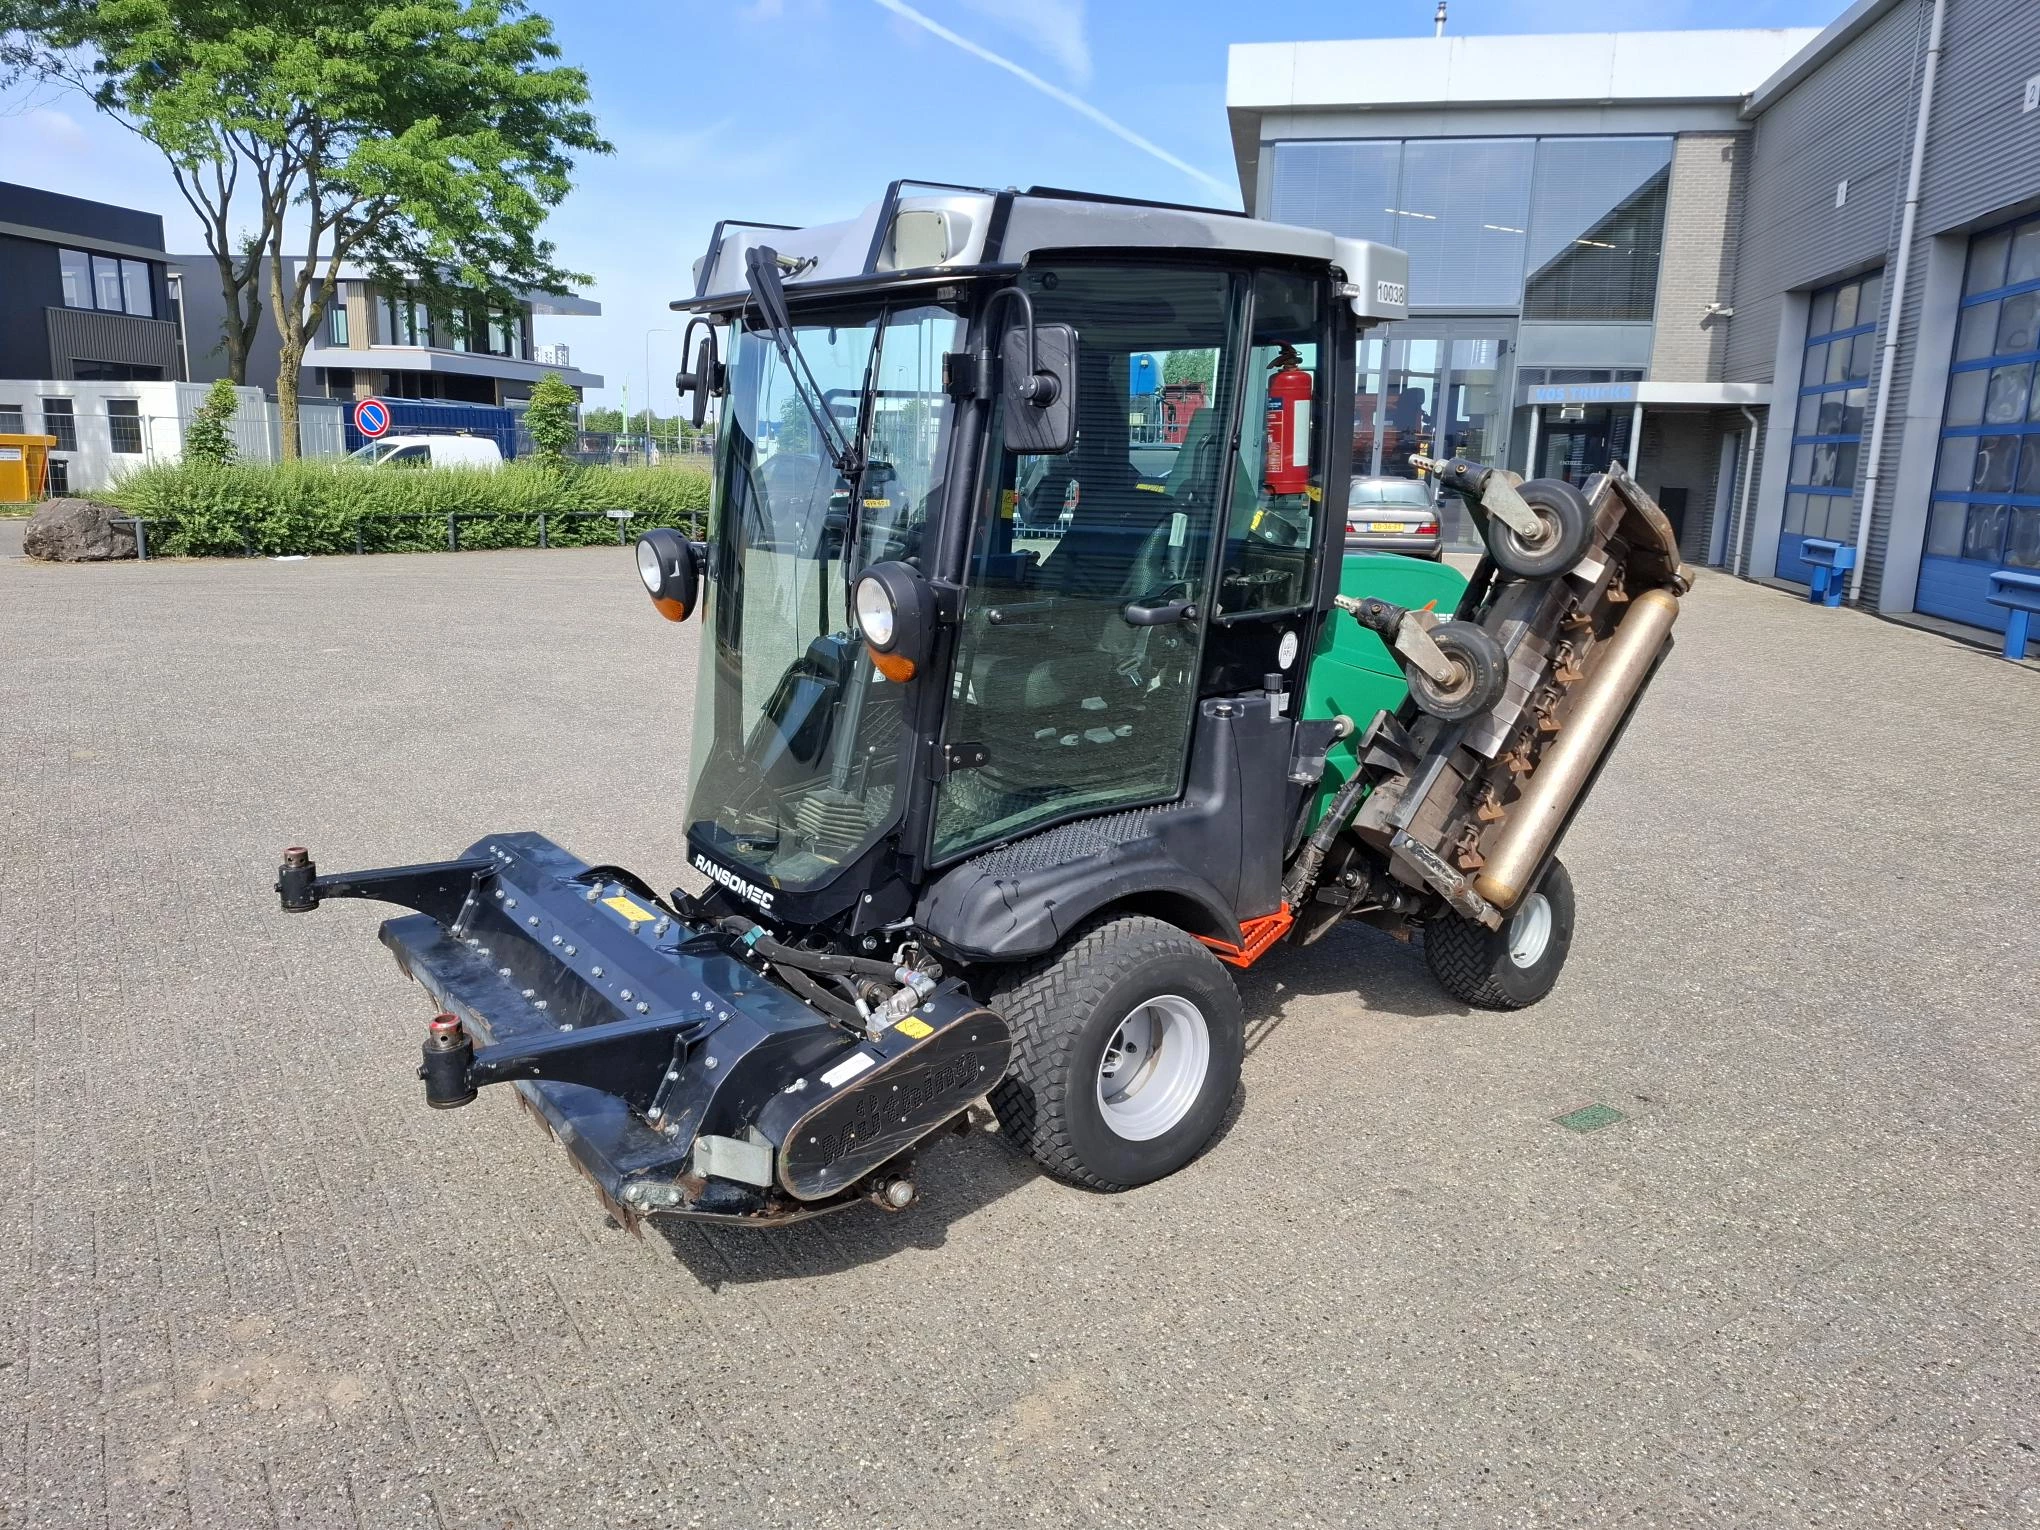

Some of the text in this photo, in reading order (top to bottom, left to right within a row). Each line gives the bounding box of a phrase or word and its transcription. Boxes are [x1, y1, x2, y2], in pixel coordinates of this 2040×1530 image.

[1379, 283, 1404, 304] 10038
[1536, 385, 1632, 401] VOS TRUCKS
